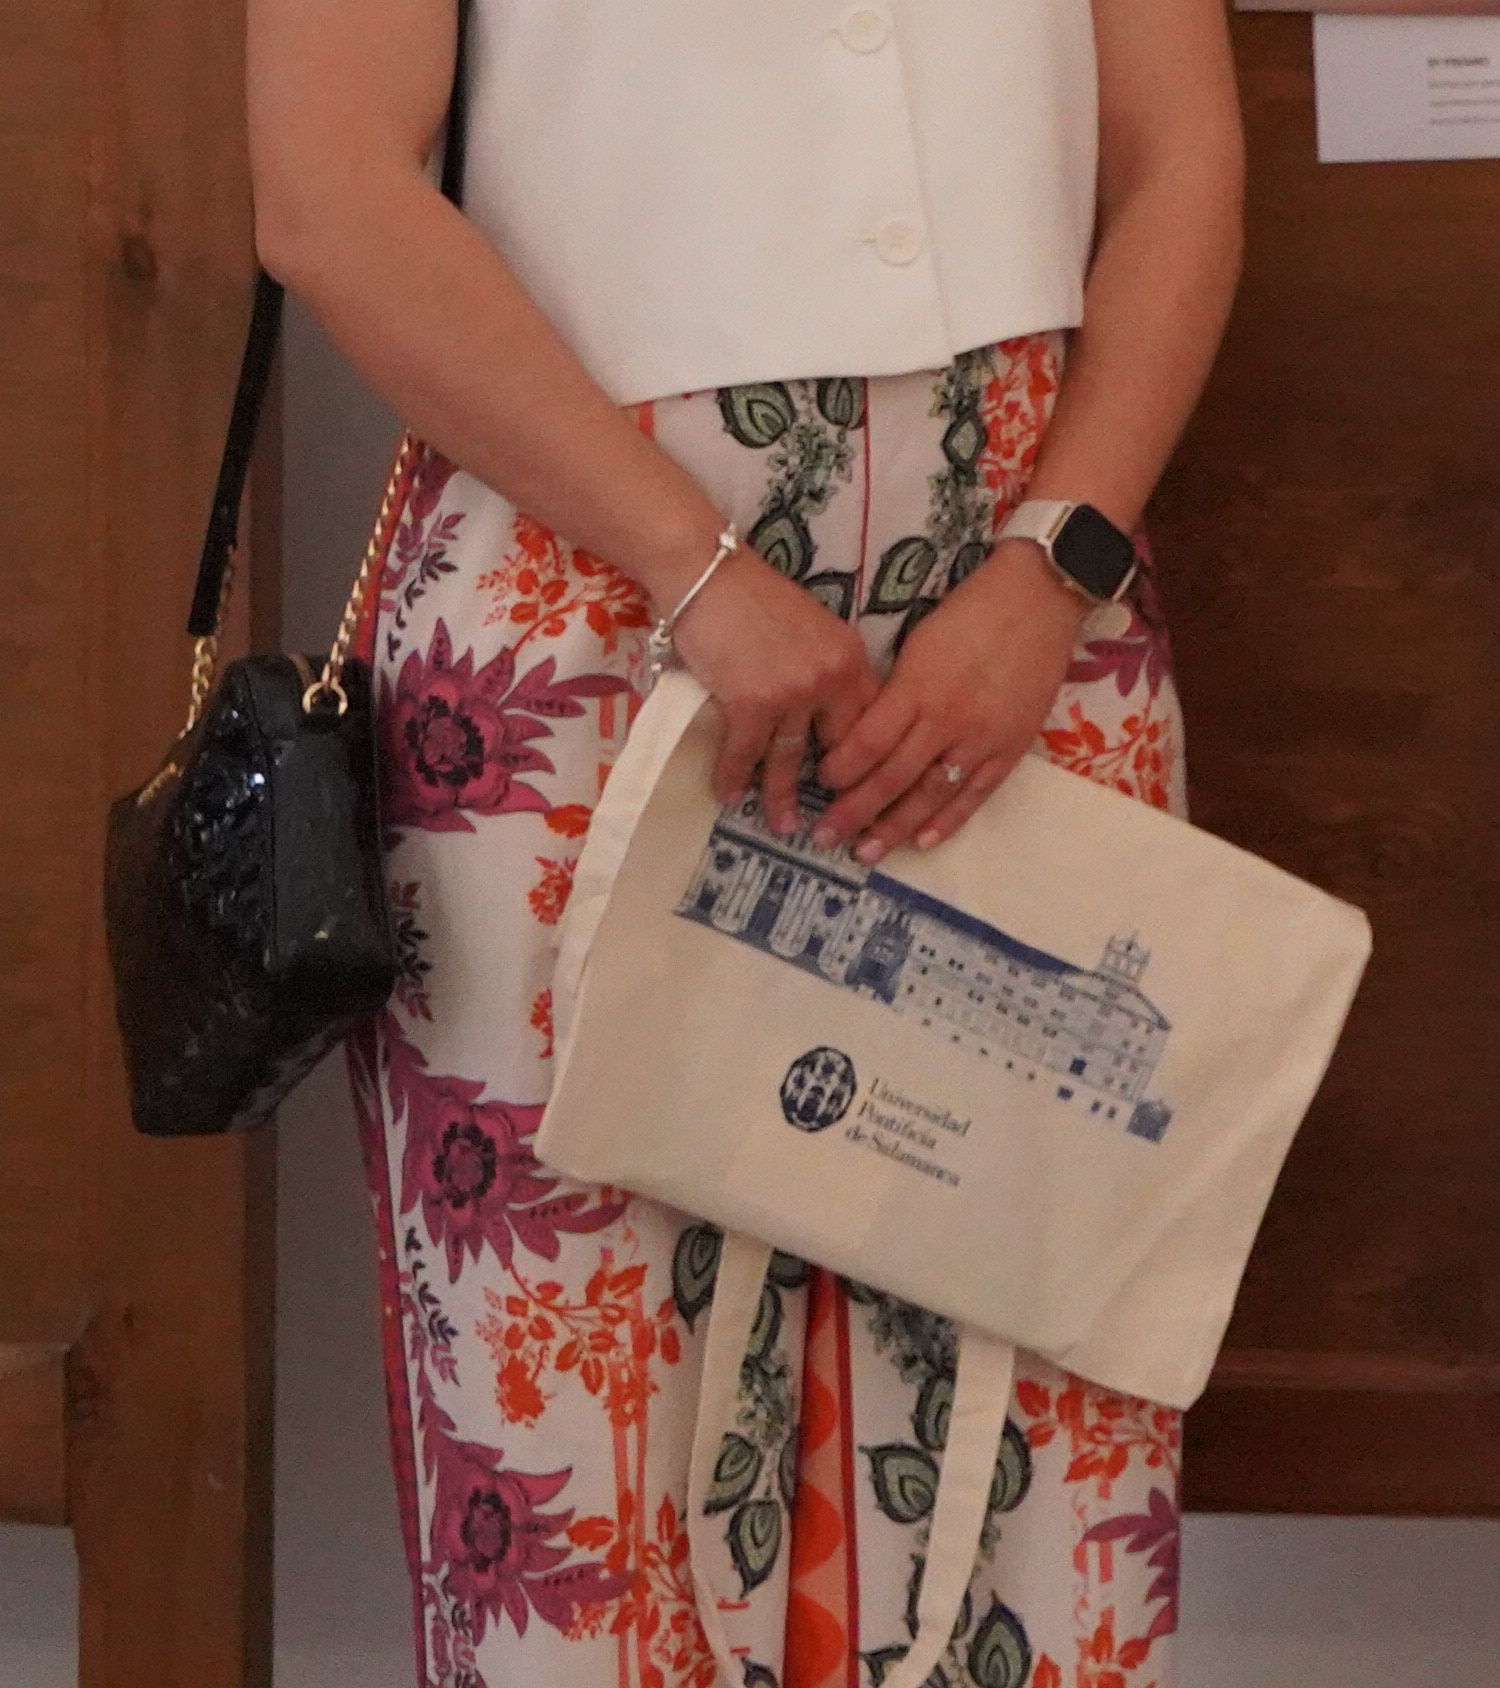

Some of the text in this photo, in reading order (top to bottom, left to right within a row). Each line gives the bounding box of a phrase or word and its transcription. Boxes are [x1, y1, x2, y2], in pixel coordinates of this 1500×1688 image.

[858, 1100, 938, 1150] Pontificia
[869, 1077, 973, 1137] Universidad
[845, 1126, 961, 1188] de Salamanca
